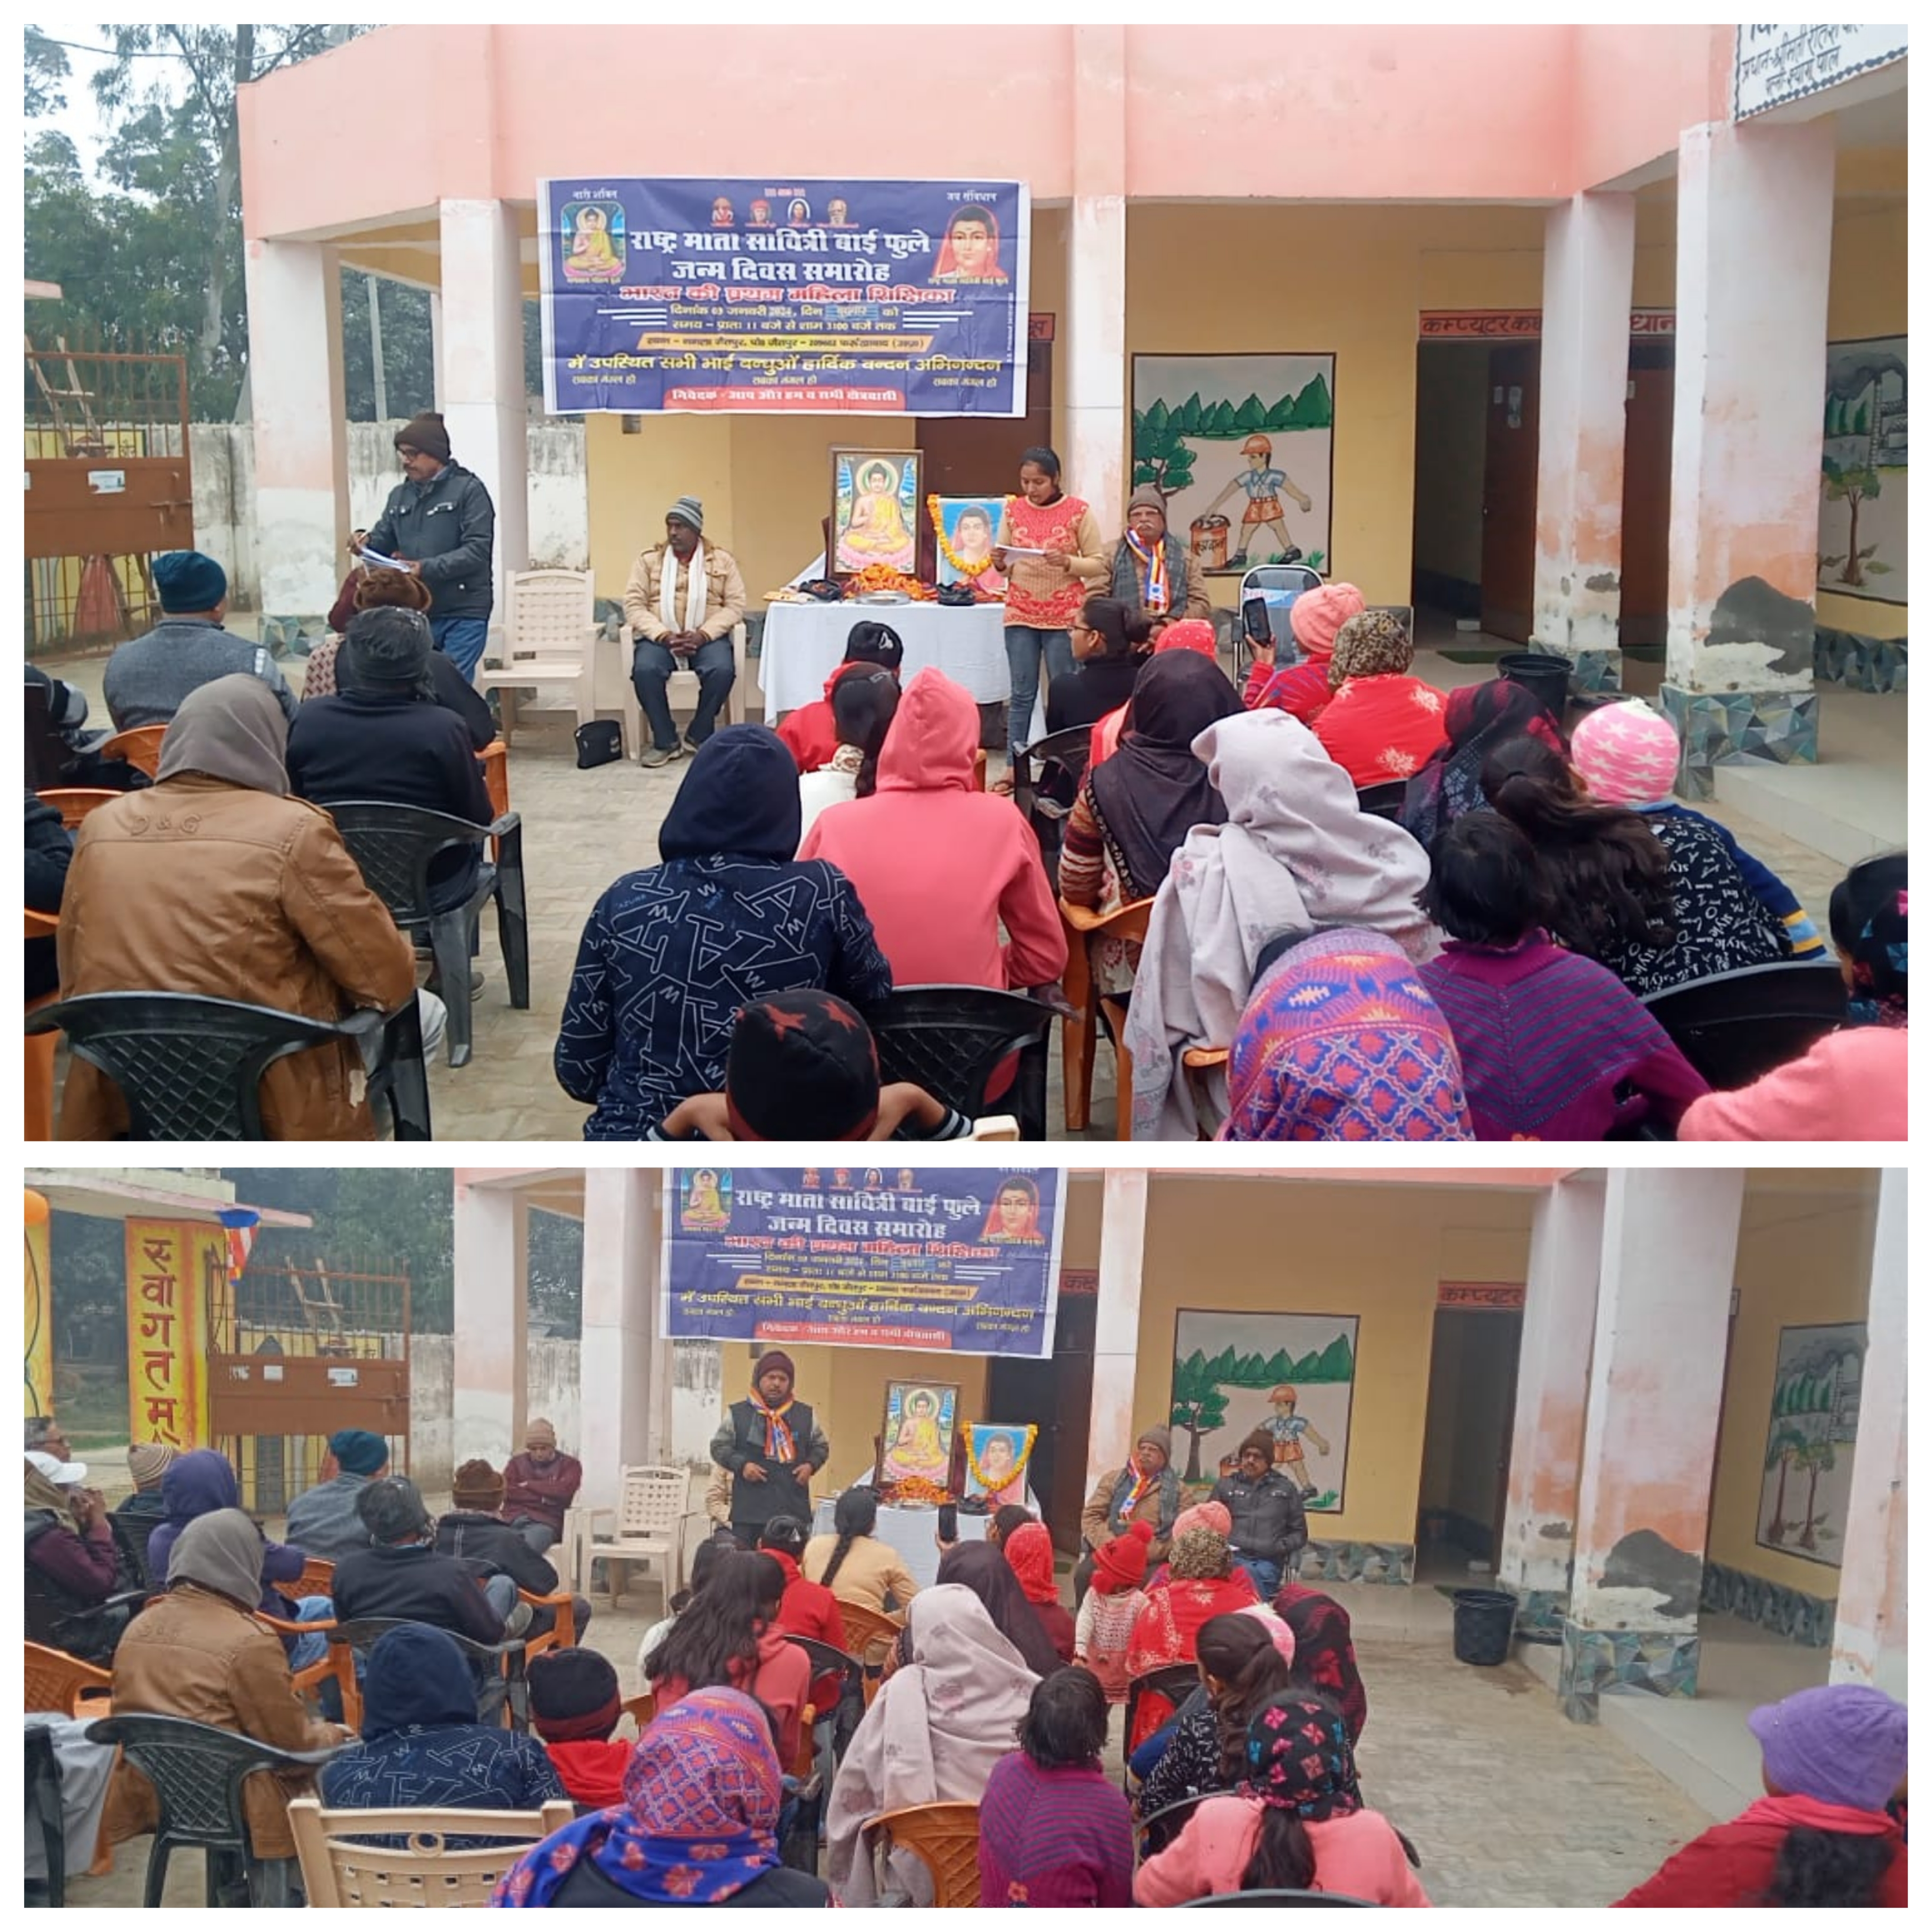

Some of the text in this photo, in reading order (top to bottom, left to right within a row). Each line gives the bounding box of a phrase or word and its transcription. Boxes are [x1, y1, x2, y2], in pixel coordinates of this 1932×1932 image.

[631, 228, 930, 258] राष्ट्र माता सावित्री बाई फुले
[671, 258, 890, 282] जन्म दिवस समारोह
[619, 285, 683, 301] भारत
[686, 283, 721, 301] की
[725, 287, 784, 303] प्रथम
[788, 283, 863, 303] महिला
[670, 303, 708, 315] दिनांक
[672, 320, 703, 329] समय
[567, 354, 587, 370] में
[589, 354, 654, 370] उपस्थित
[660, 353, 697, 371] सभी
[701, 352, 734, 371] भाई
[672, 389, 717, 400] निवेदक
[728, 390, 755, 400] आप
[758, 389, 783, 400] और
[735, 1189, 982, 1220] राष्ट्र माता सावित्री बाई फुले
[766, 1213, 947, 1240] जन्म दिवस समारोह
